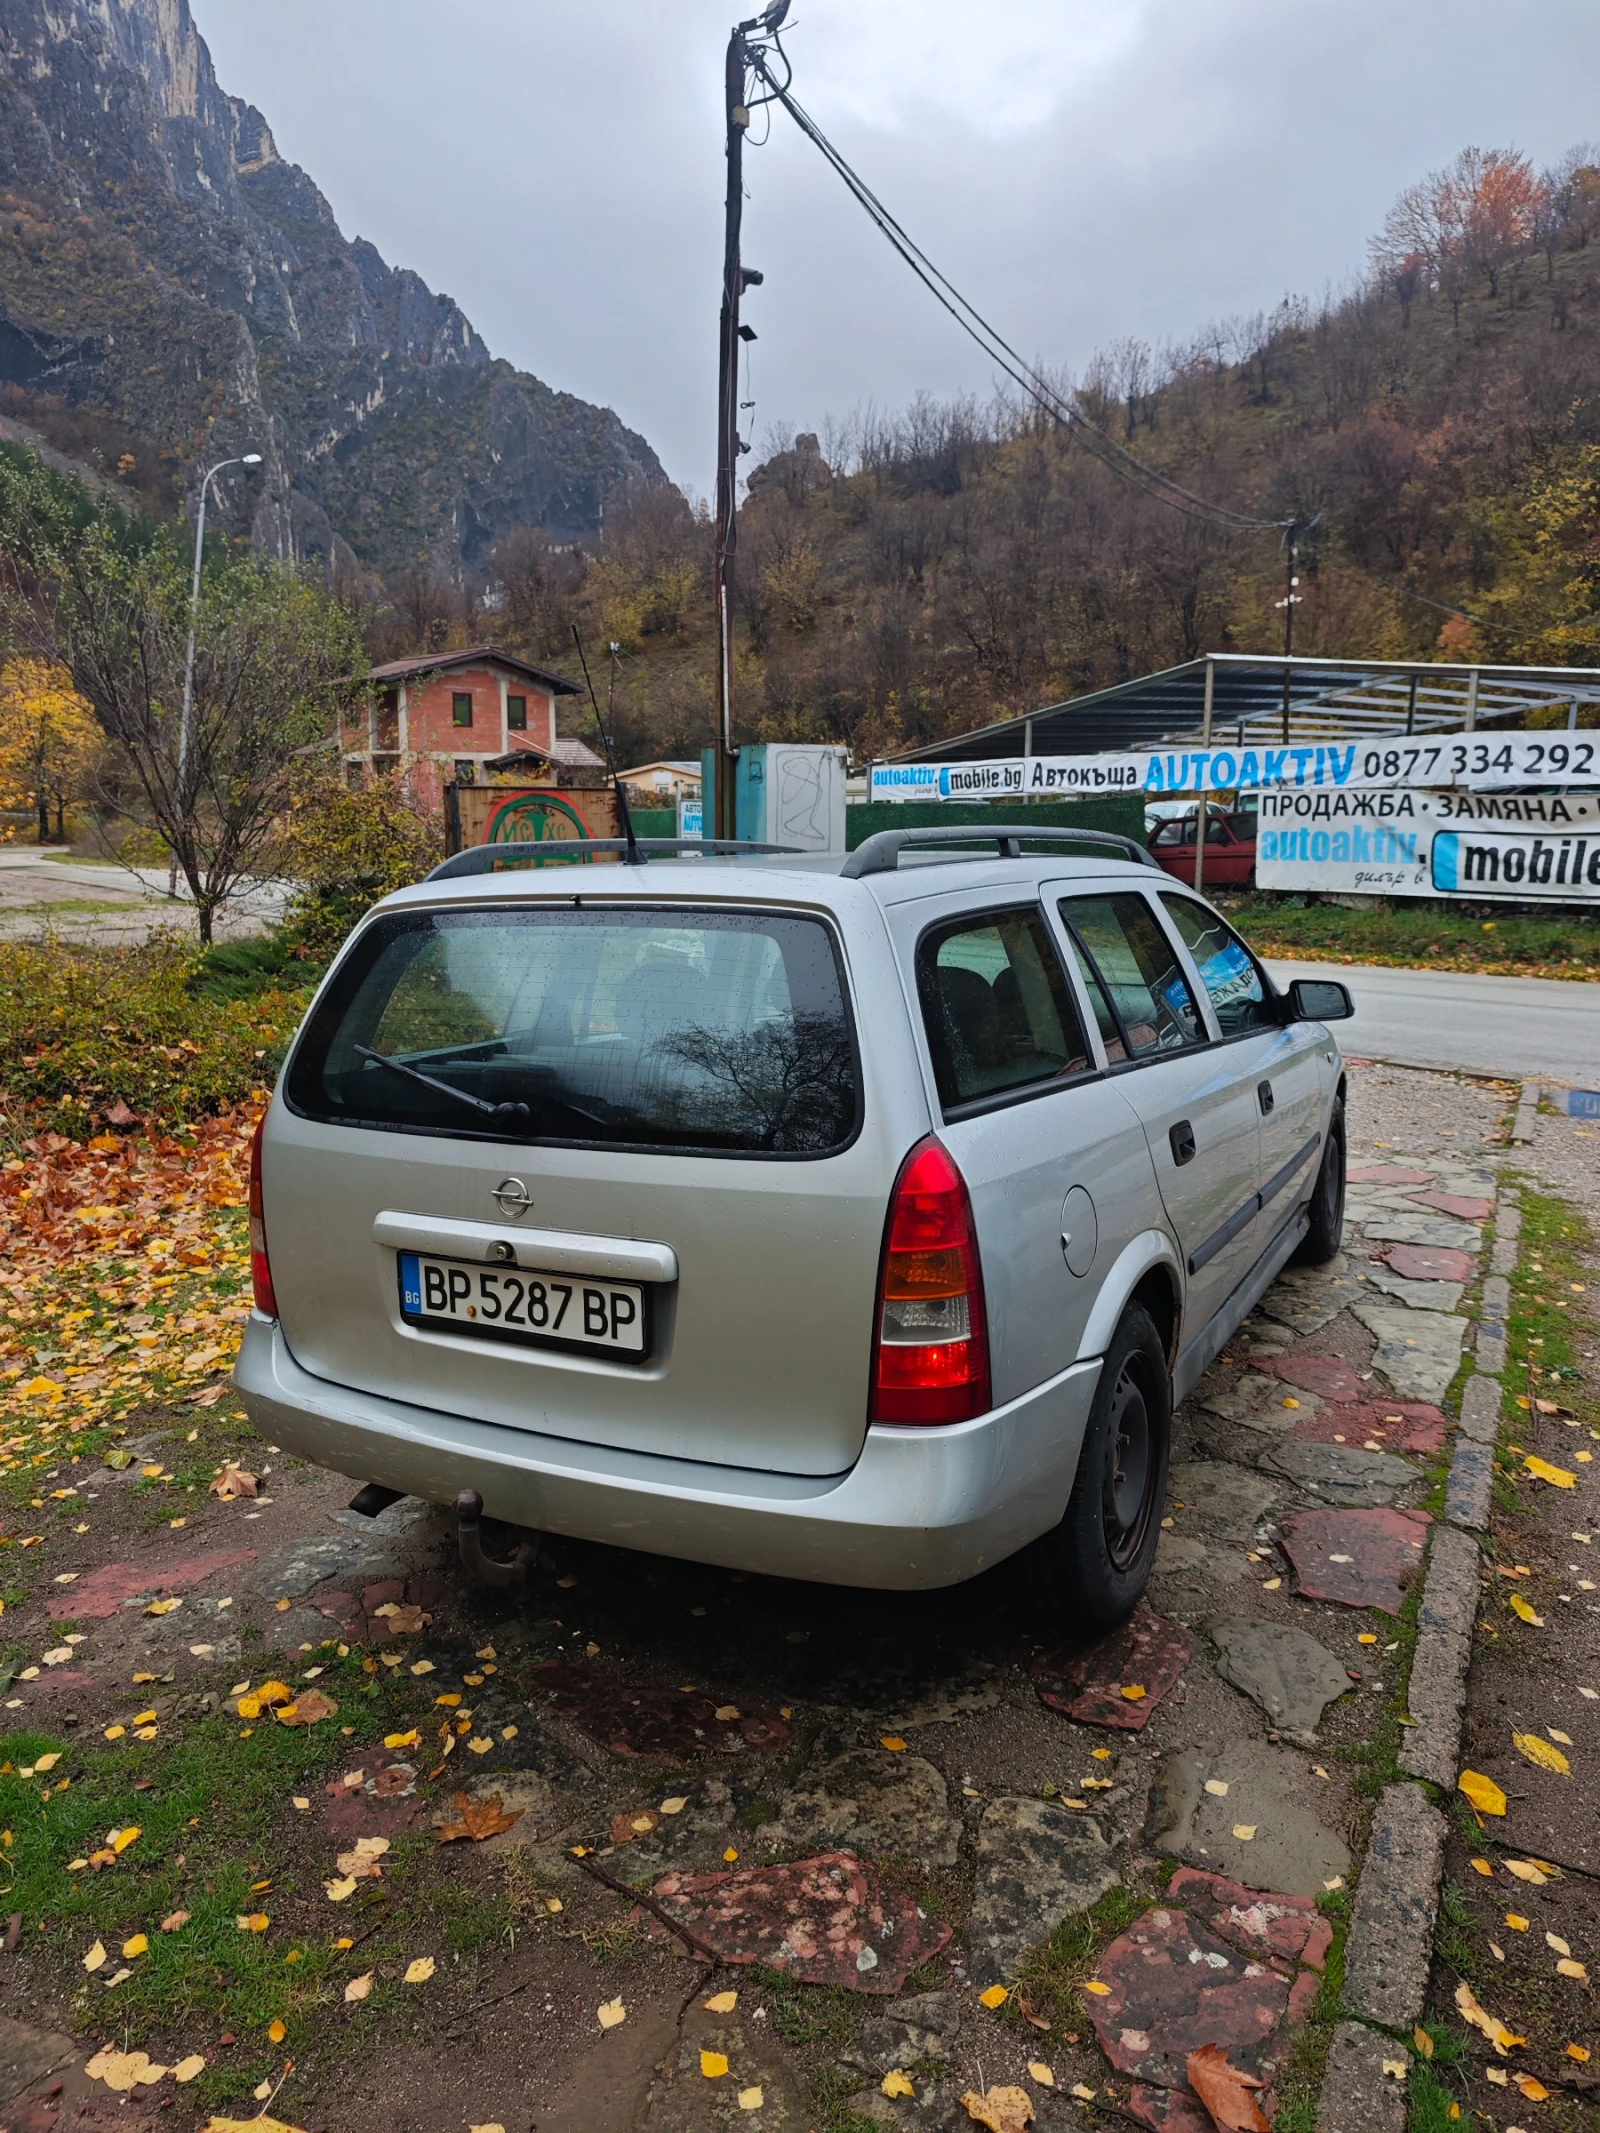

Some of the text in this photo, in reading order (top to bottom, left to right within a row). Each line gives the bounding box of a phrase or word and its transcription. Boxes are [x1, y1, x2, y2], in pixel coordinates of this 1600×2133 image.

[950, 767, 1022, 790] mobile.bg
[1031, 762, 1137, 787] Автокъща
[1144, 745, 1356, 791] AUTOAKTIV
[1363, 747, 1441, 778] 0877
[1451, 745, 1514, 774] 334
[1523, 743, 1595, 775] 292
[1262, 794, 1414, 821] ПРОДАЖБА
[1436, 795, 1573, 822] ЗАМЯНА
[405, 1265, 635, 1339] BG BP 5287 BP
